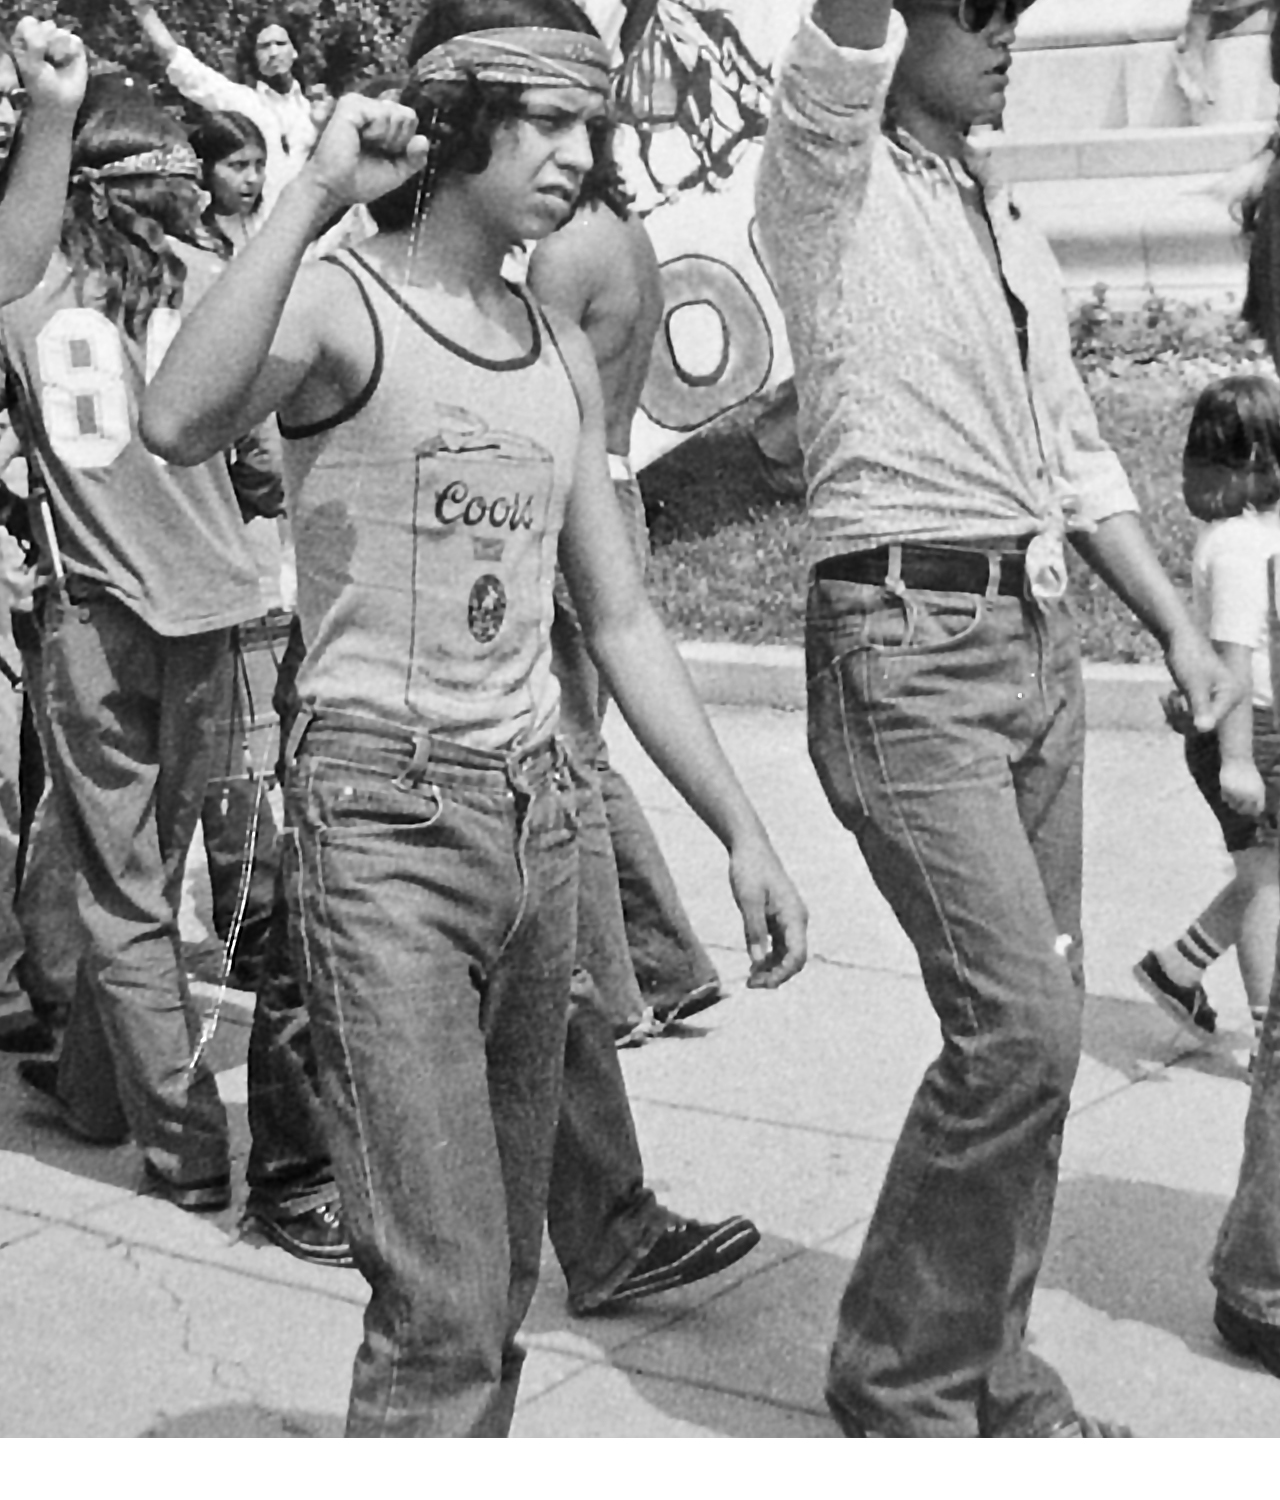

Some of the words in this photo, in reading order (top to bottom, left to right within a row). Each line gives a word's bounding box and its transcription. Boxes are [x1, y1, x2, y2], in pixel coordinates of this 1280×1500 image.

[36, 307, 182, 468] 8
[639, 217, 779, 432] O
[434, 480, 534, 531] Coors
